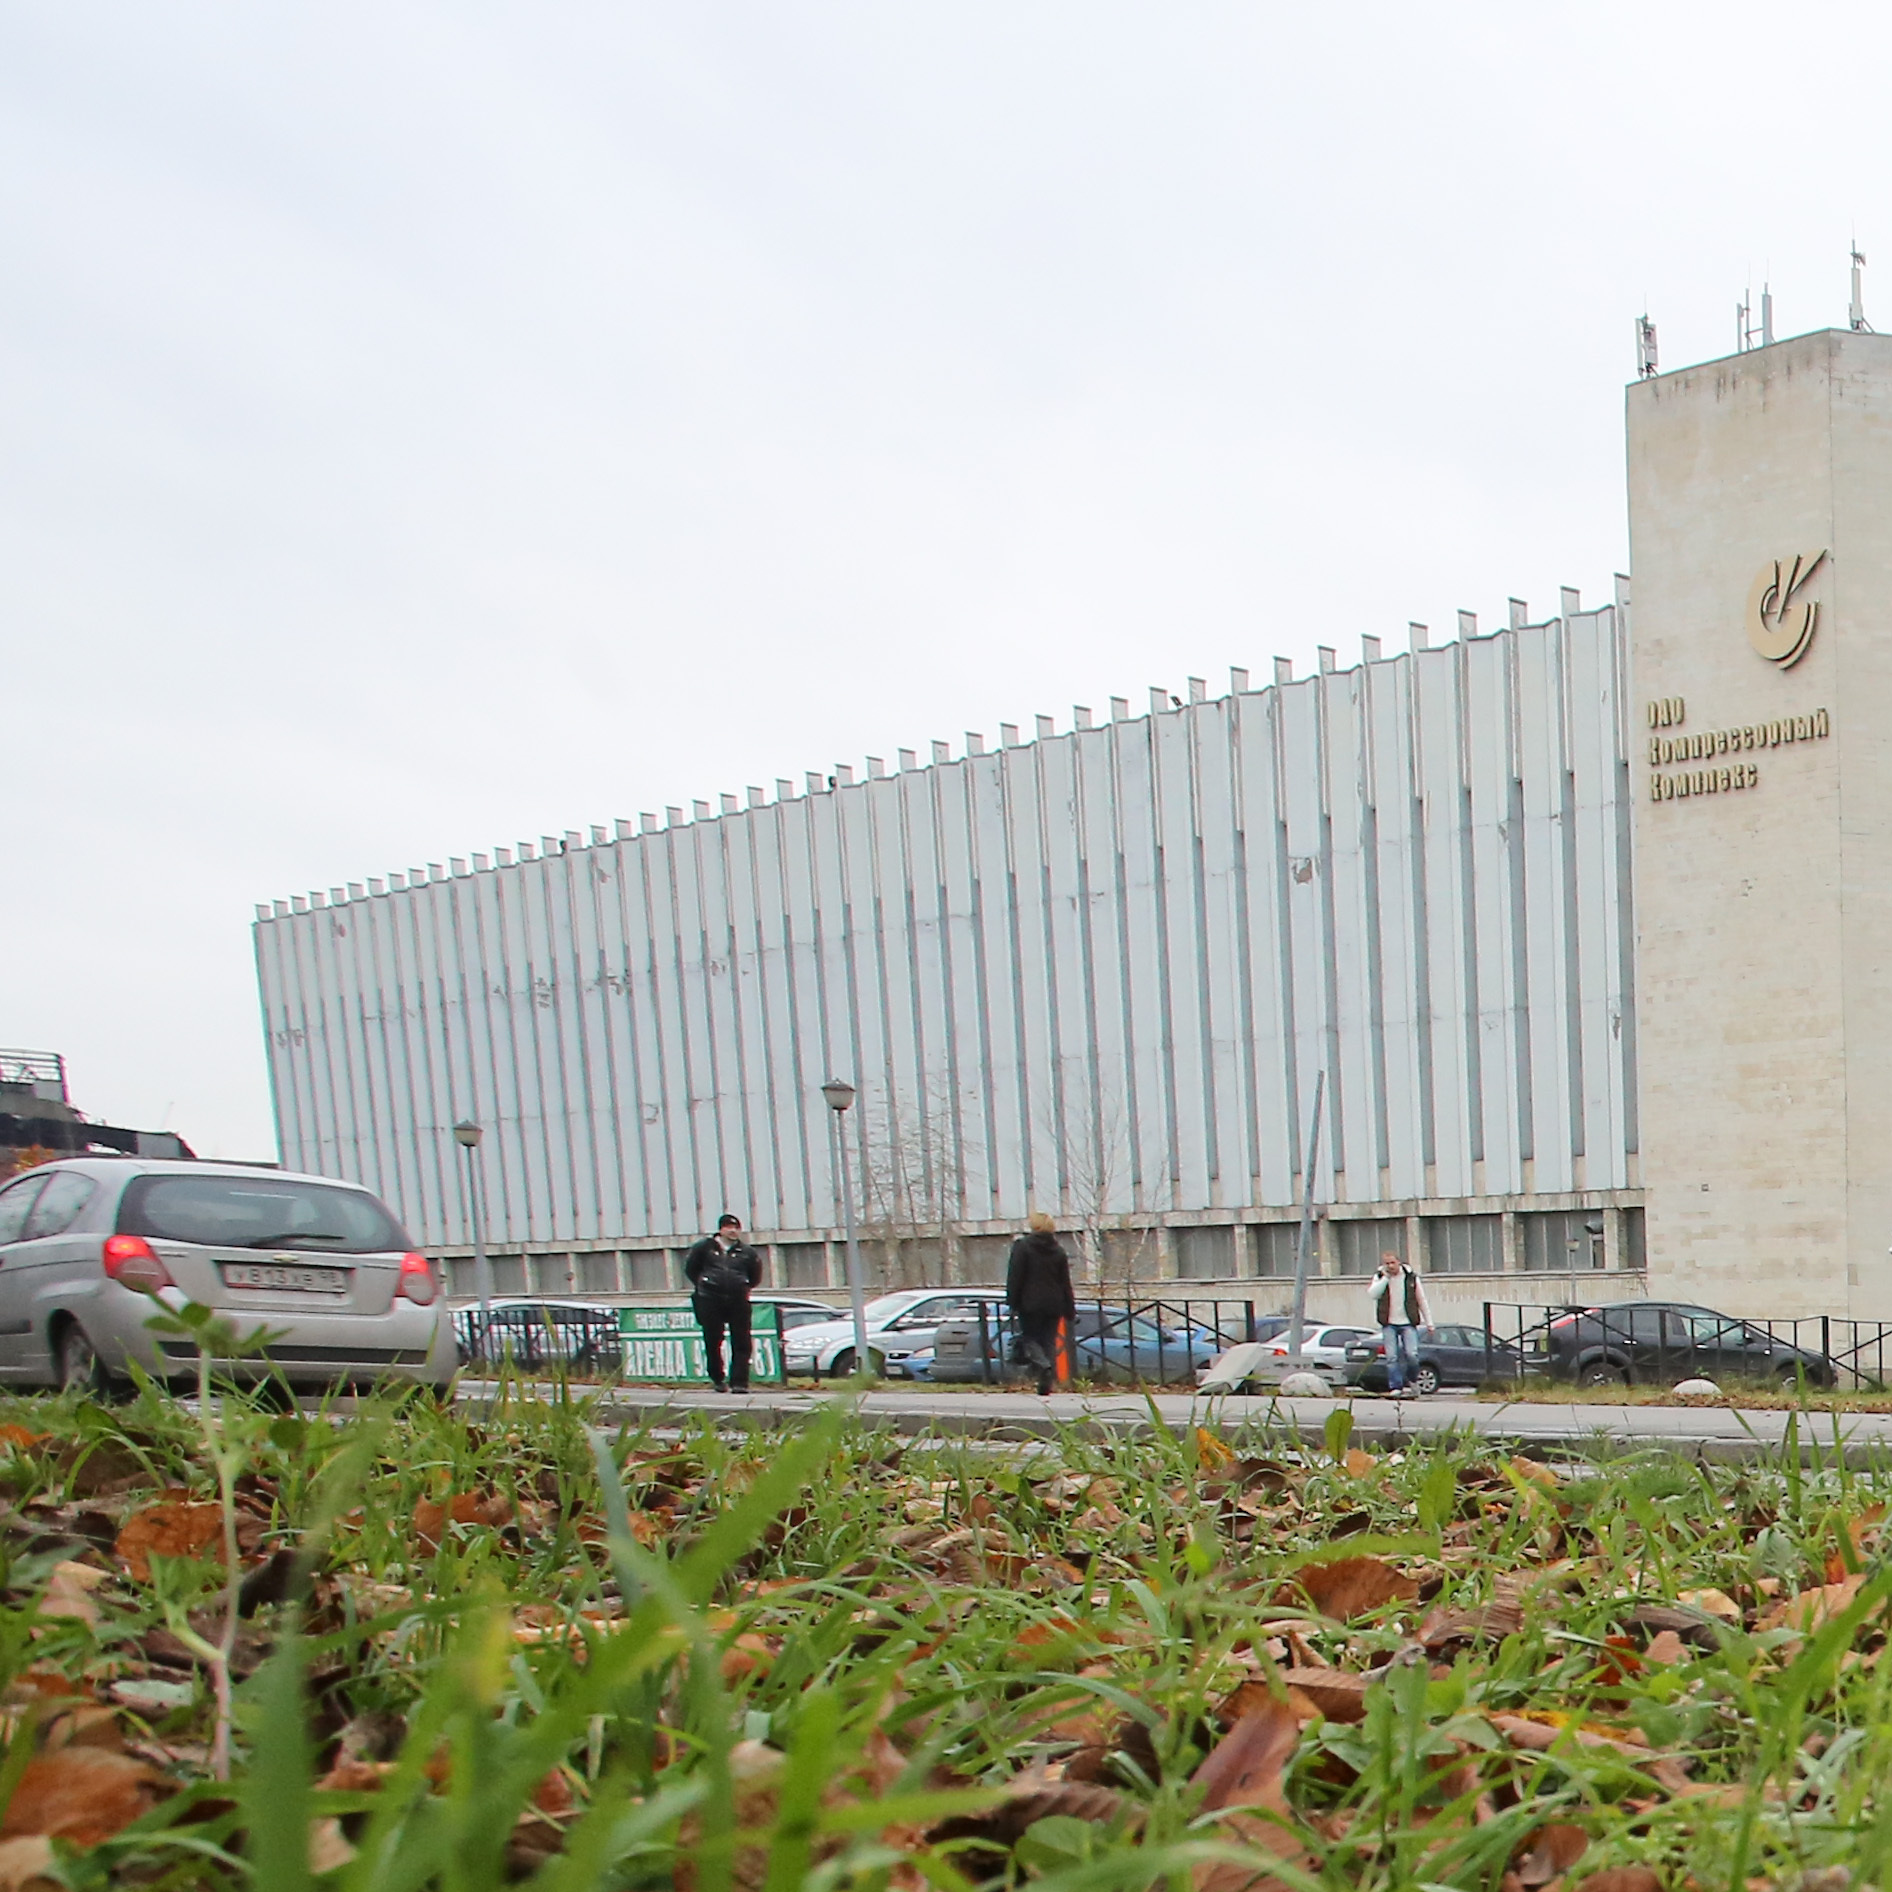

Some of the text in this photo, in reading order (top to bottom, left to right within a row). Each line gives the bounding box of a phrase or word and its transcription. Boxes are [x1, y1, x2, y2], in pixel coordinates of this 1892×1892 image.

[1648, 697, 1685, 729] ОАО
[1648, 707, 1829, 767] Компрессорный
[1649, 764, 1758, 802] Комплекс
